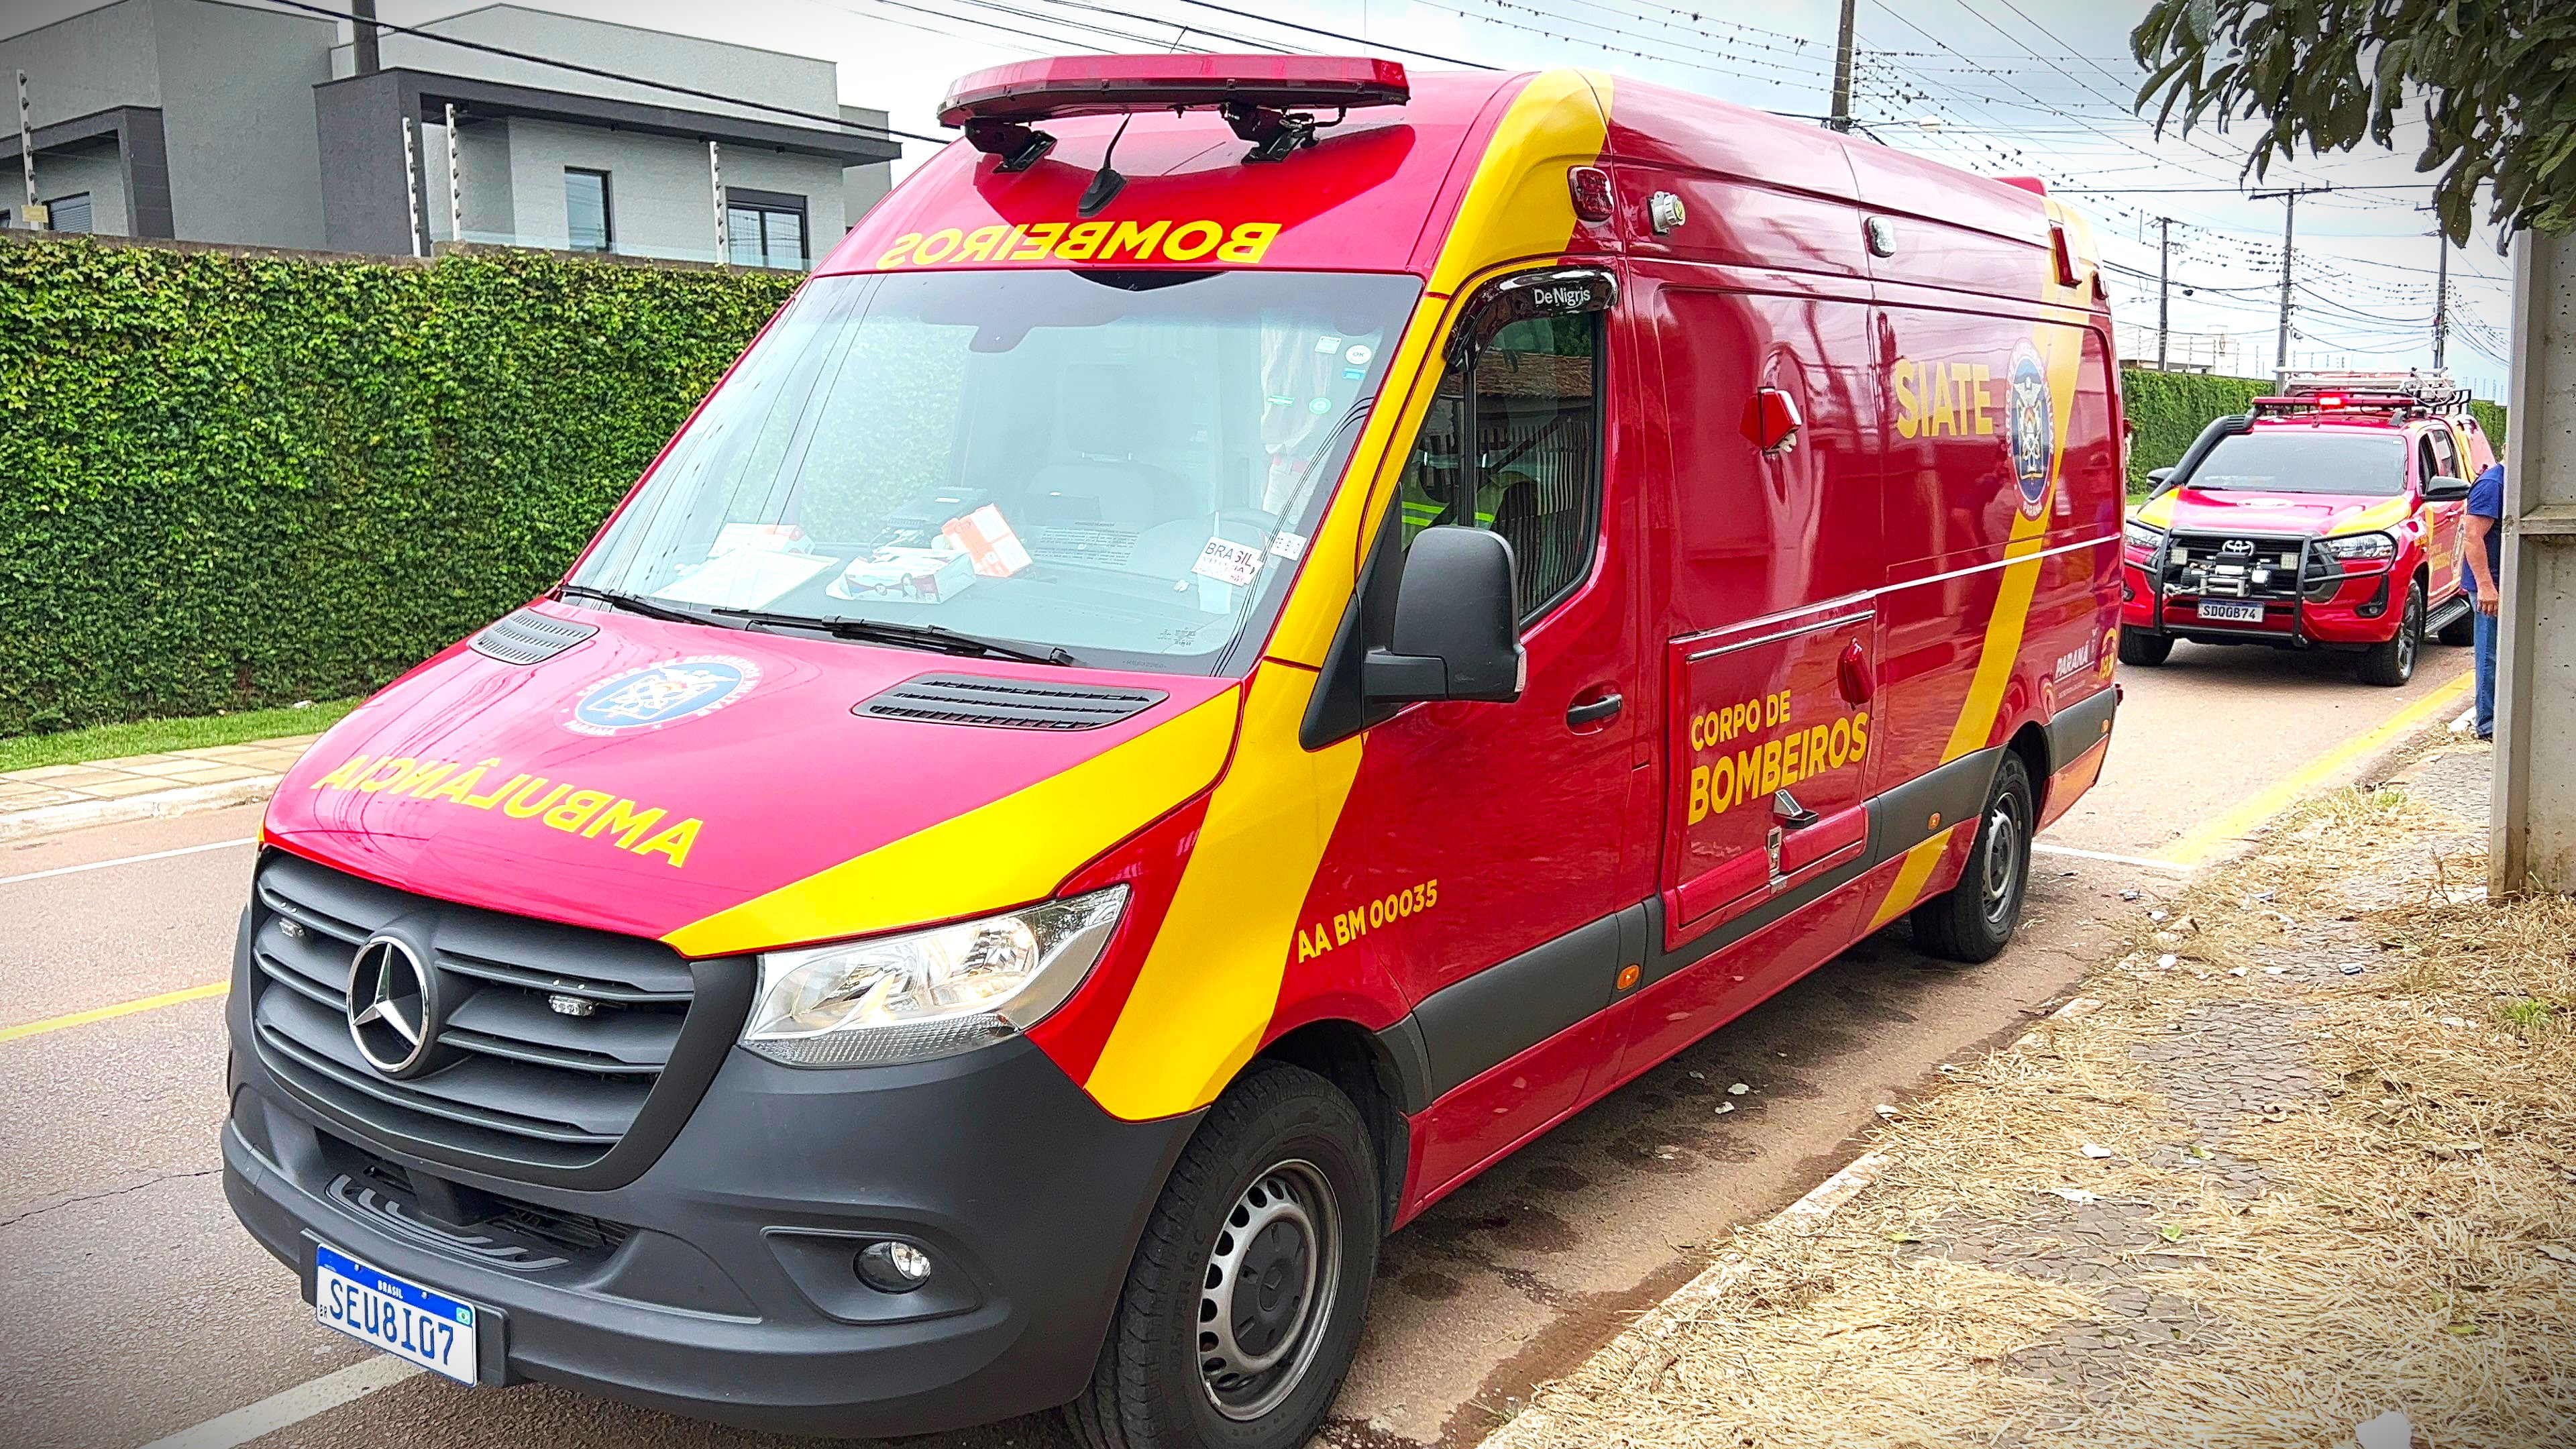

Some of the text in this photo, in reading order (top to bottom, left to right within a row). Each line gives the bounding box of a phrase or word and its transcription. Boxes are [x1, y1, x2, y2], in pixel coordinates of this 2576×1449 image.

[1894, 358, 1994, 439] SIATE
[1205, 542, 1252, 568] BRASIL
[2055, 639, 2089, 679] PARANÁ
[1690, 690, 1792, 752] CORPO DE
[1688, 712, 1868, 826] BOMBEIROS
[1298, 878, 1438, 963] AA BM 00035
[329, 1277, 454, 1366] SEU8I07
[377, 1279, 404, 1299] BRASIL
